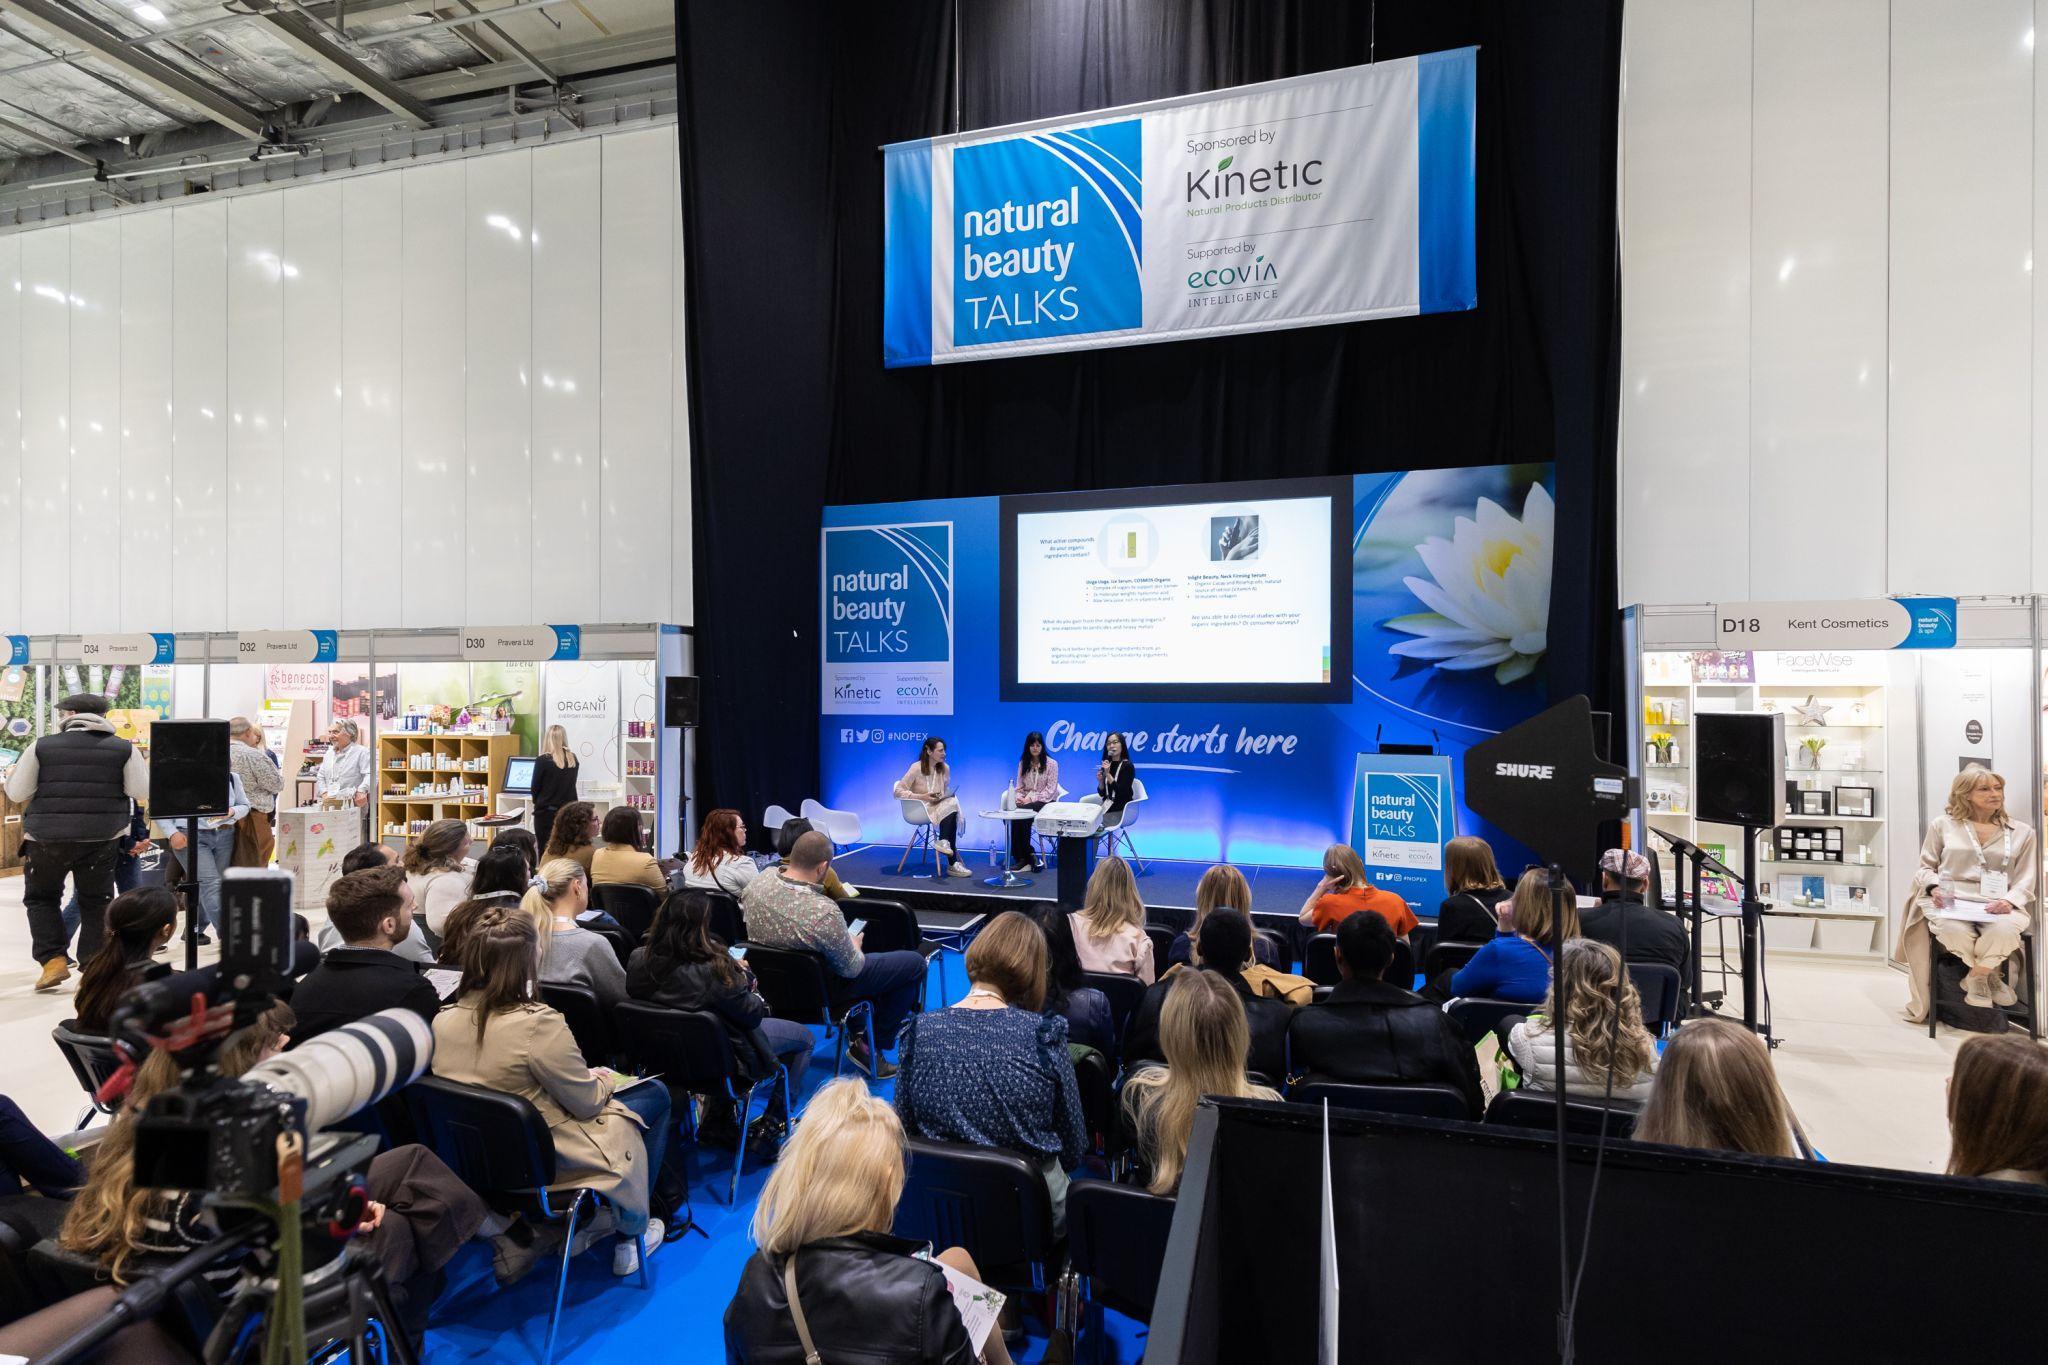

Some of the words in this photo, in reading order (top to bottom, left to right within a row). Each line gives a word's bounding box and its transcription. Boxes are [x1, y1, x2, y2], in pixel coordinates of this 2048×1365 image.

[1187, 129, 1256, 155] Sponsored
[1260, 129, 1276, 145] by
[1187, 159, 1323, 202] Kinetic
[964, 186, 1079, 239] natural
[1187, 203, 1222, 217] Natural
[1225, 199, 1268, 214] Products
[1270, 191, 1323, 206] Distributor
[1187, 242, 1242, 260] Supported
[1243, 242, 1256, 254] by
[964, 238, 1075, 282] beauty
[1188, 289, 1279, 308] INTELLIGENCE
[965, 286, 1080, 330] TALKS
[833, 565, 909, 592] natural
[833, 596, 906, 627] beauty
[1722, 618, 1760, 633] D18
[1788, 619, 1817, 629] Kent
[1821, 617, 1889, 629] Cosmetics
[1918, 622, 1938, 630] beauty
[84, 644, 99, 654] D34
[129, 644, 138, 652] Ltd
[239, 642, 256, 652] D32
[288, 642, 298, 650] Ltd
[466, 638, 485, 649] D30
[522, 638, 534, 646] Ltd
[833, 630, 909, 653] TALKS
[281, 670, 325, 684] benecos
[860, 675, 866, 683] by
[921, 675, 929, 683] by
[834, 686, 881, 699] Kinetic
[888, 732, 929, 741] #NOPEX
[1152, 722, 1229, 754] starts
[1235, 726, 1298, 755] here
[1495, 762, 1553, 780] SHURE
[1371, 794, 1416, 807] natural
[1371, 807, 1414, 824] beauty
[1372, 823, 1416, 838] TALKS
[1373, 851, 1400, 860] Kinetic
